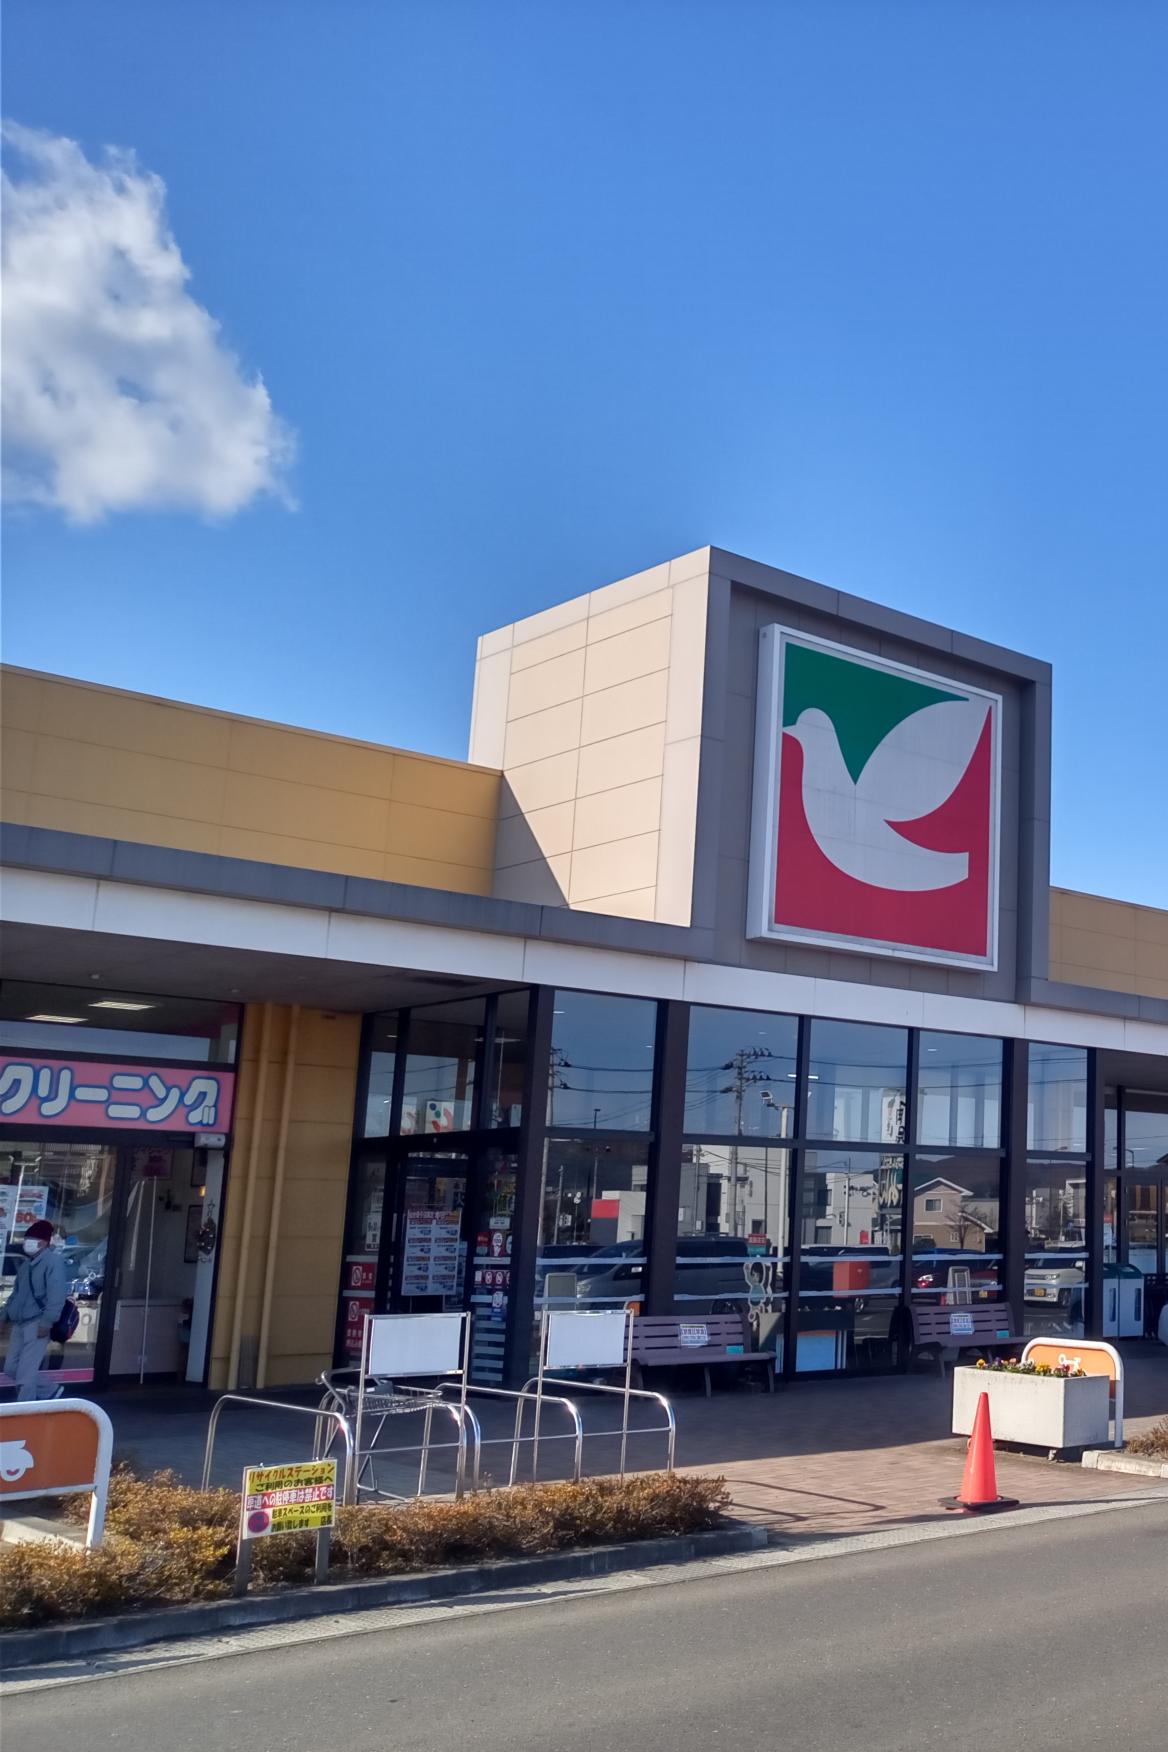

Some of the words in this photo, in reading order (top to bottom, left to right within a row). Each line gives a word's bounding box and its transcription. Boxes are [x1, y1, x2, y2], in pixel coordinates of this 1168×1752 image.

[0, 1063, 220, 1125] クリーニング
[249, 1464, 335, 1483] リサイクルステーション
[256, 1476, 333, 1492] ご利用のお客様へ
[247, 1487, 335, 1511] 車道への駐停車は禁止です
